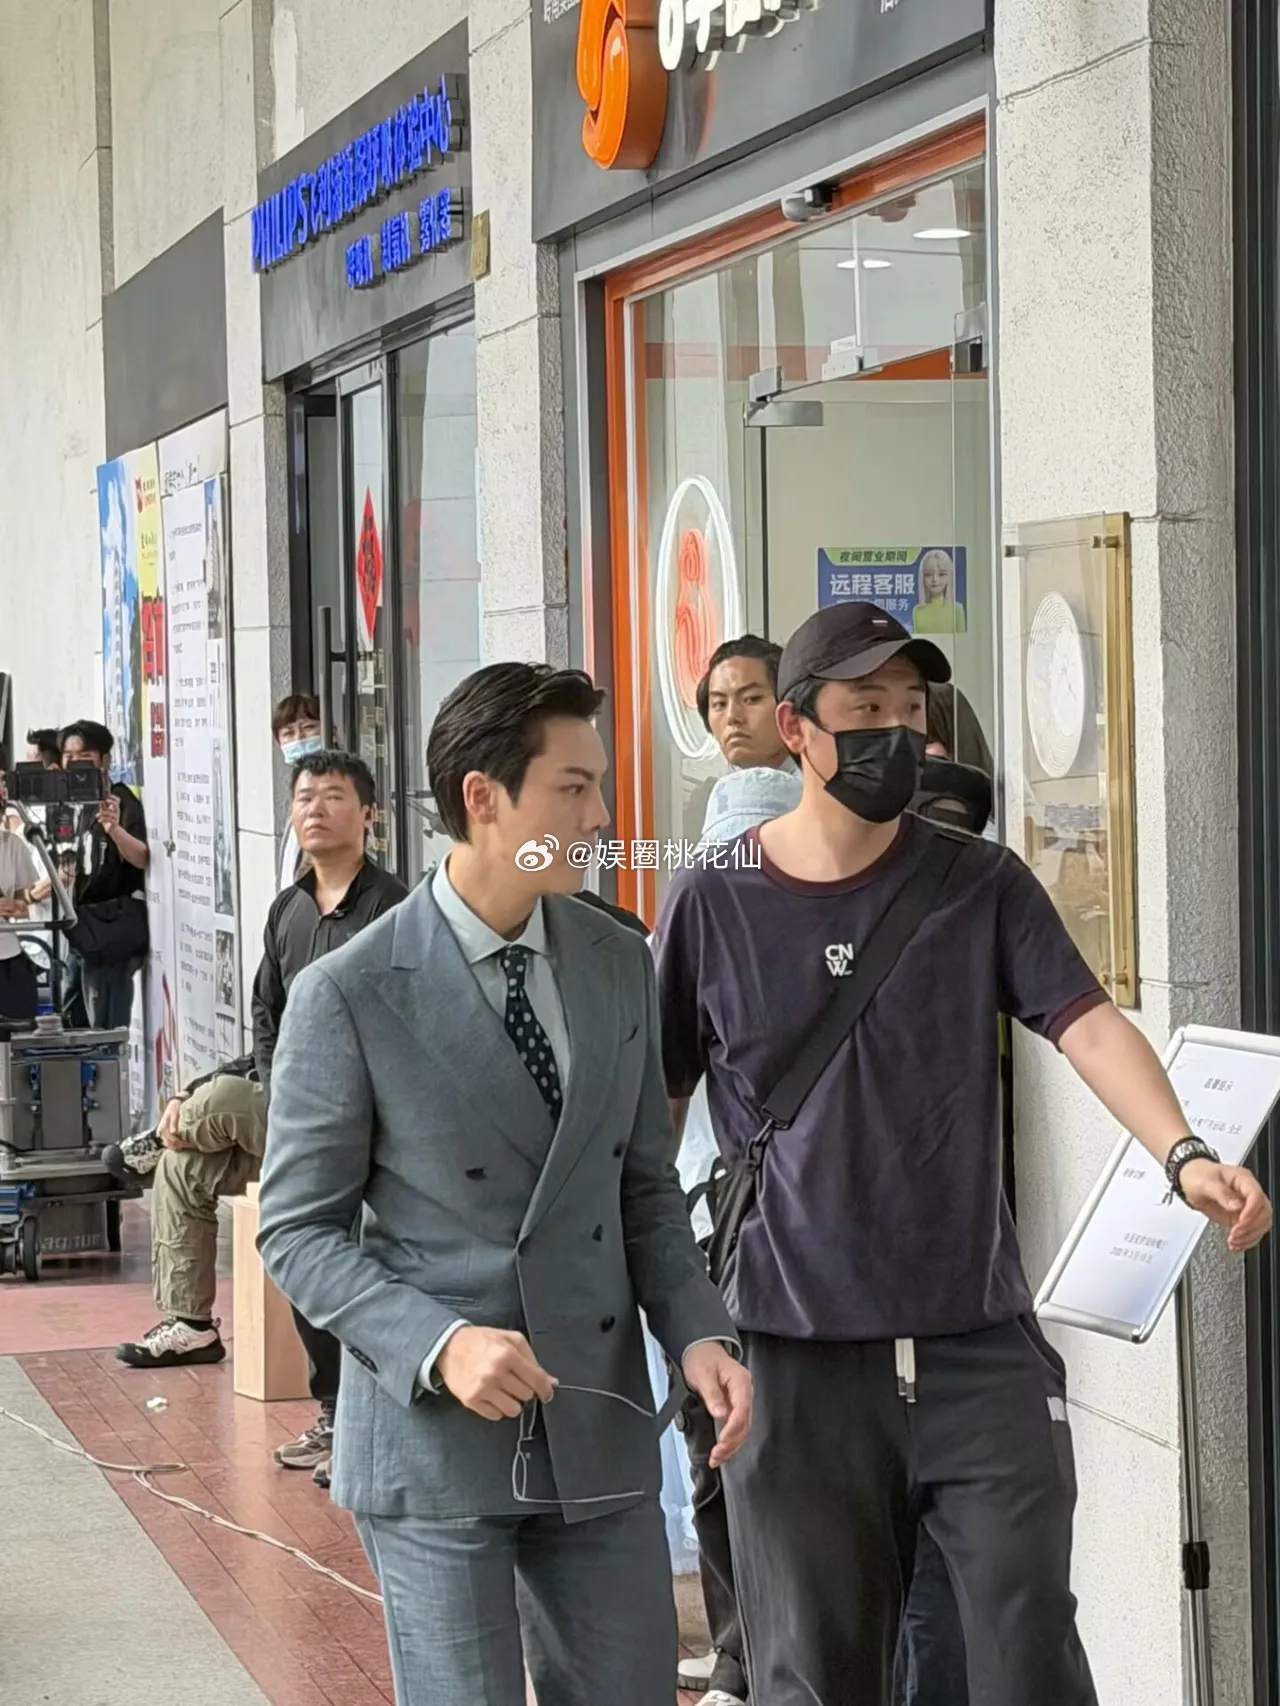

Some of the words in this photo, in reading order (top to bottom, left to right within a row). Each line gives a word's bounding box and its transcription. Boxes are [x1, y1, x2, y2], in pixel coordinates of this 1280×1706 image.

[251, 172, 308, 273] PHILIPS
[829, 573, 916, 596] 远程客服
[825, 943, 854, 960] CN
